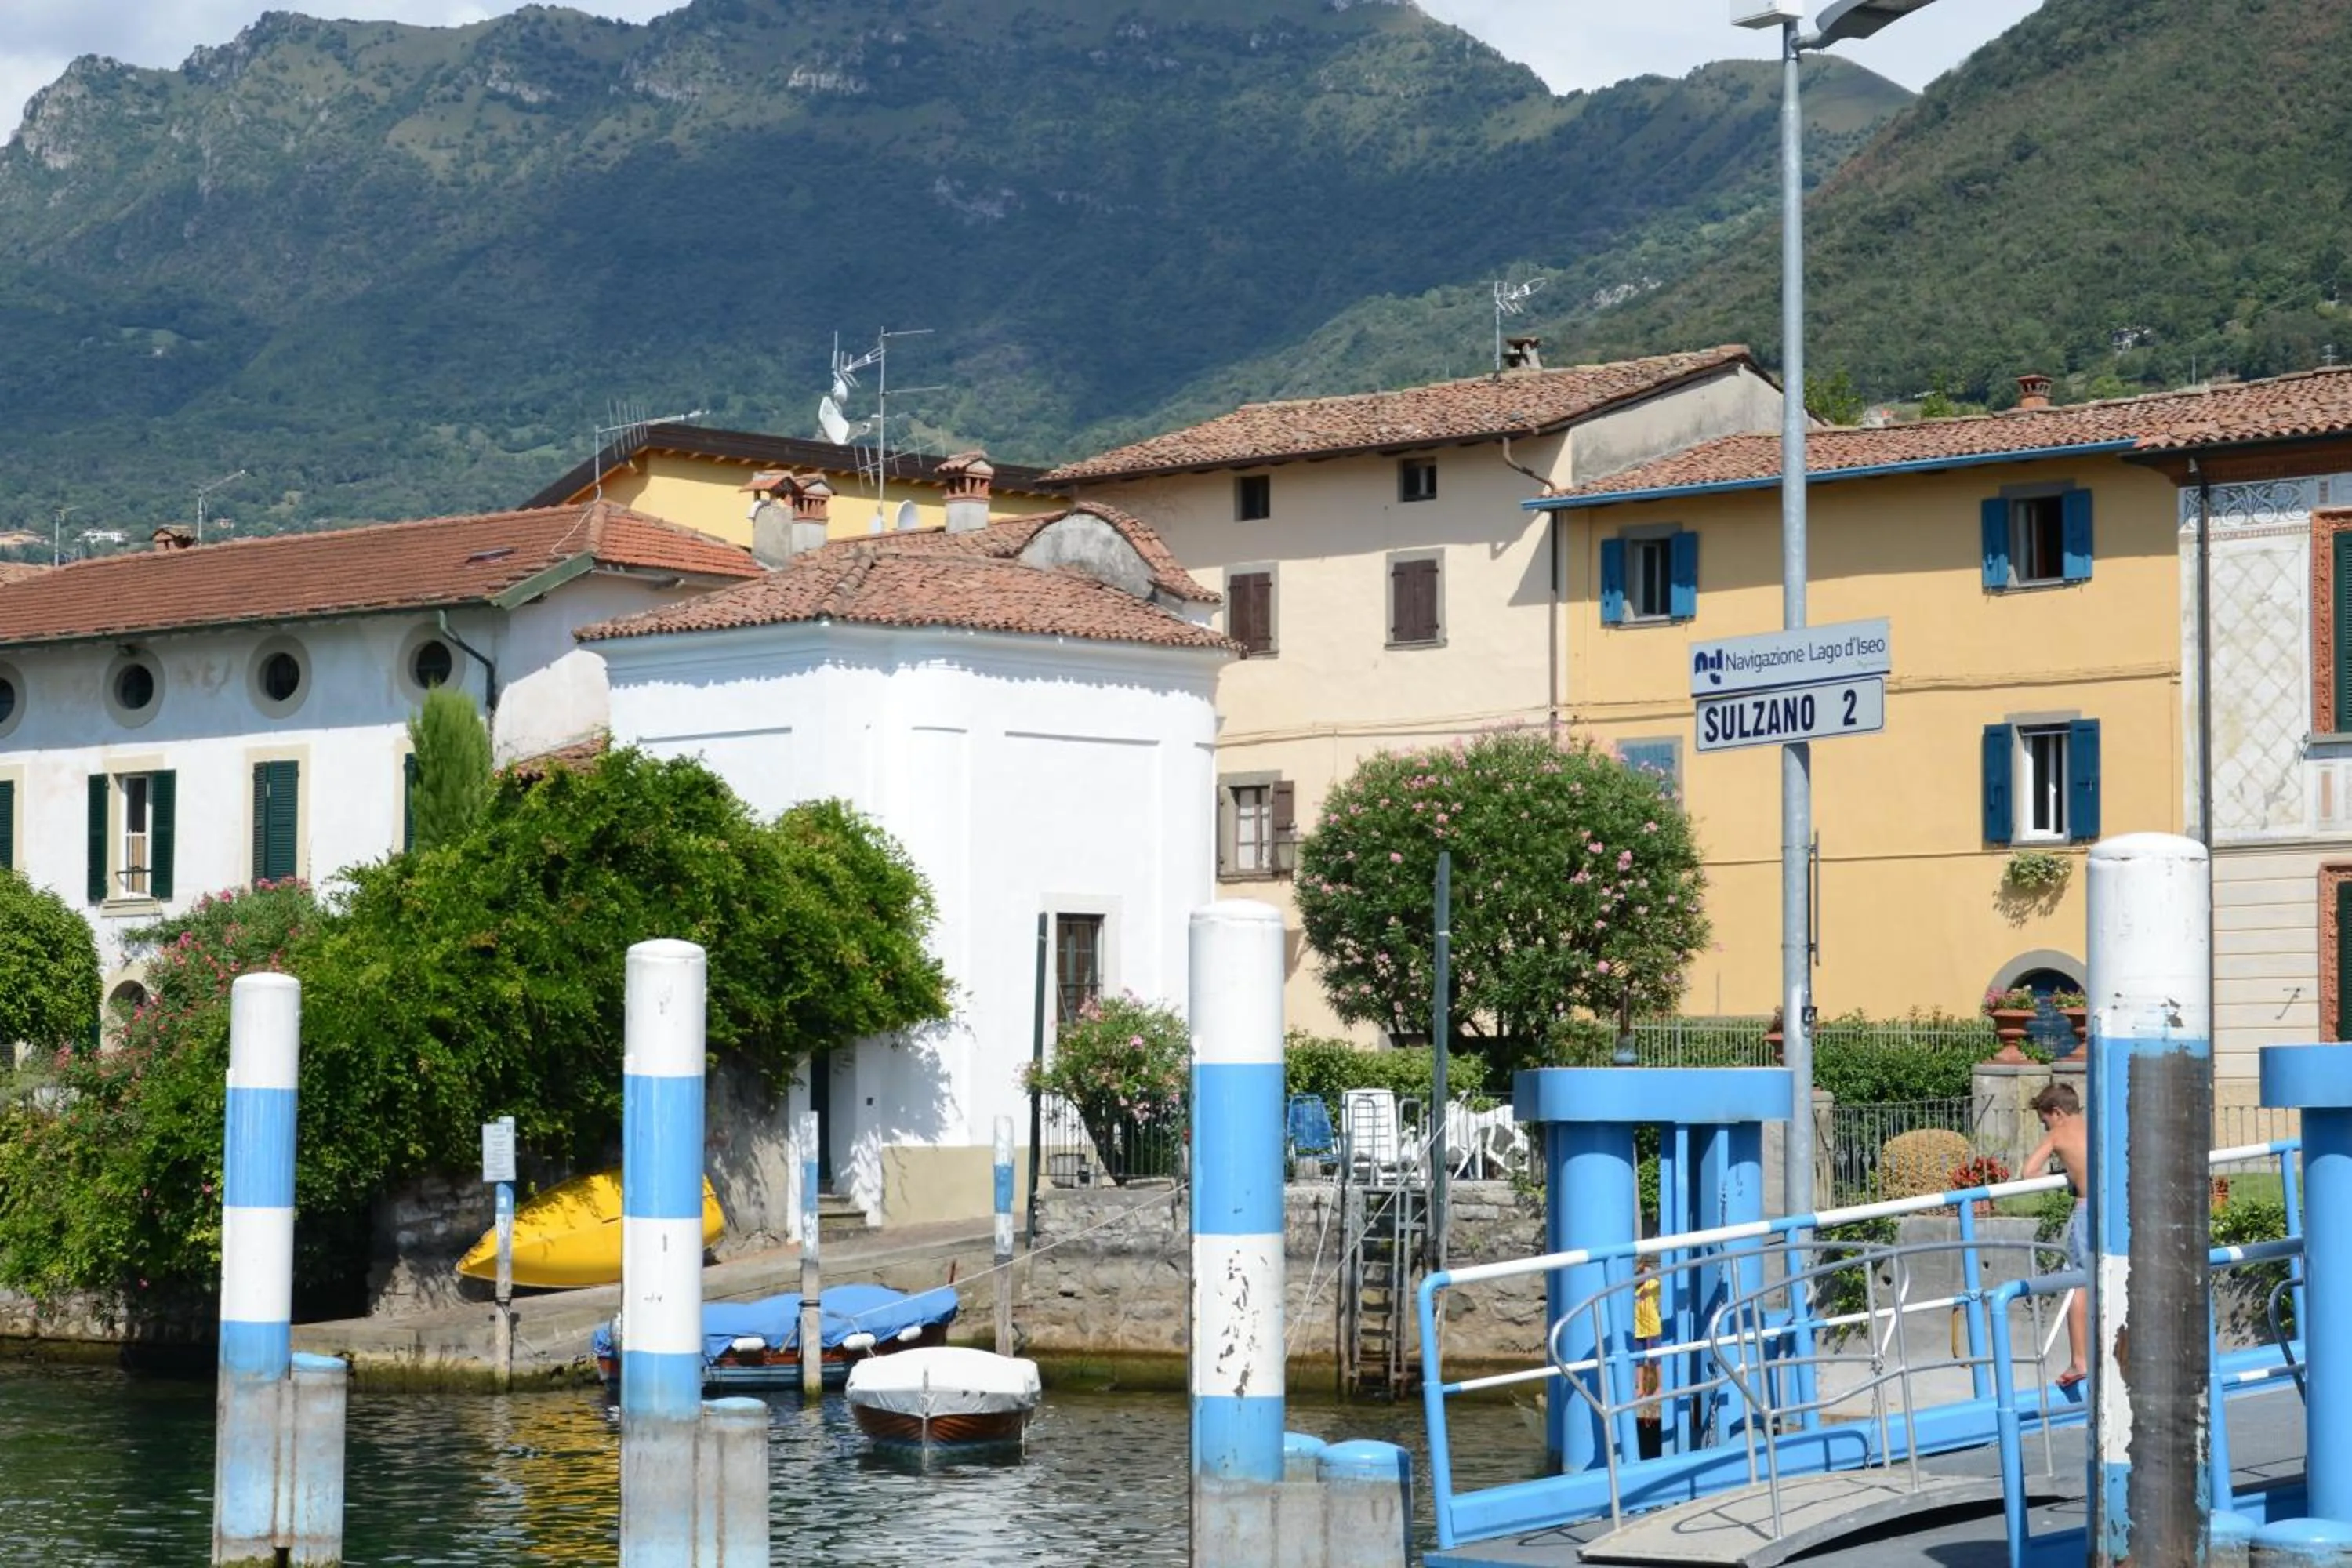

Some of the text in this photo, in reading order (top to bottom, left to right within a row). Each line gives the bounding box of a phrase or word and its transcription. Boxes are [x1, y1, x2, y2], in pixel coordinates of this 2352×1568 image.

[1726, 636, 1886, 673] Navigazione Lago d'Iseo
[1704, 689, 1857, 742] SULZANO 2
